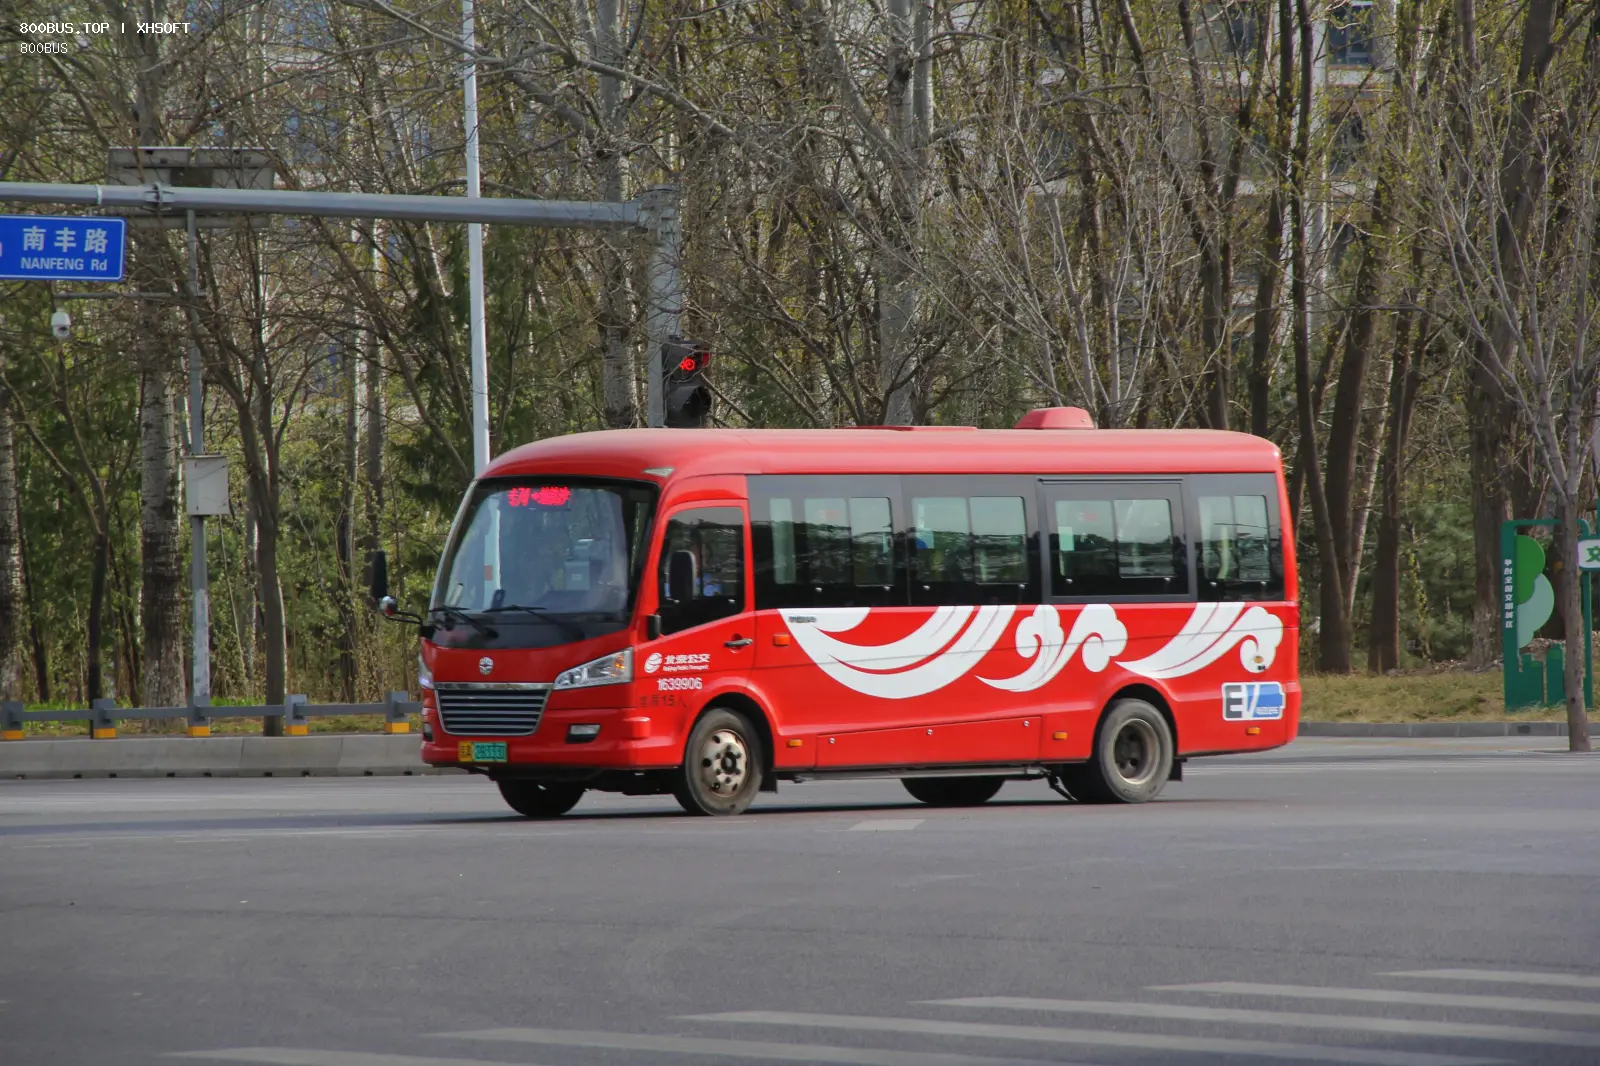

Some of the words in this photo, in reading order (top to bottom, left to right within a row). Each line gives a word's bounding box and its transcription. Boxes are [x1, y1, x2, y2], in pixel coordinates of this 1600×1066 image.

[23, 225, 108, 254] 南丰路
[20, 257, 84, 271] NANFENG
[90, 258, 107, 271] Rd
[664, 653, 711, 665] 北京公交
[657, 677, 703, 691] 1639906
[1225, 684, 1260, 719] EV
